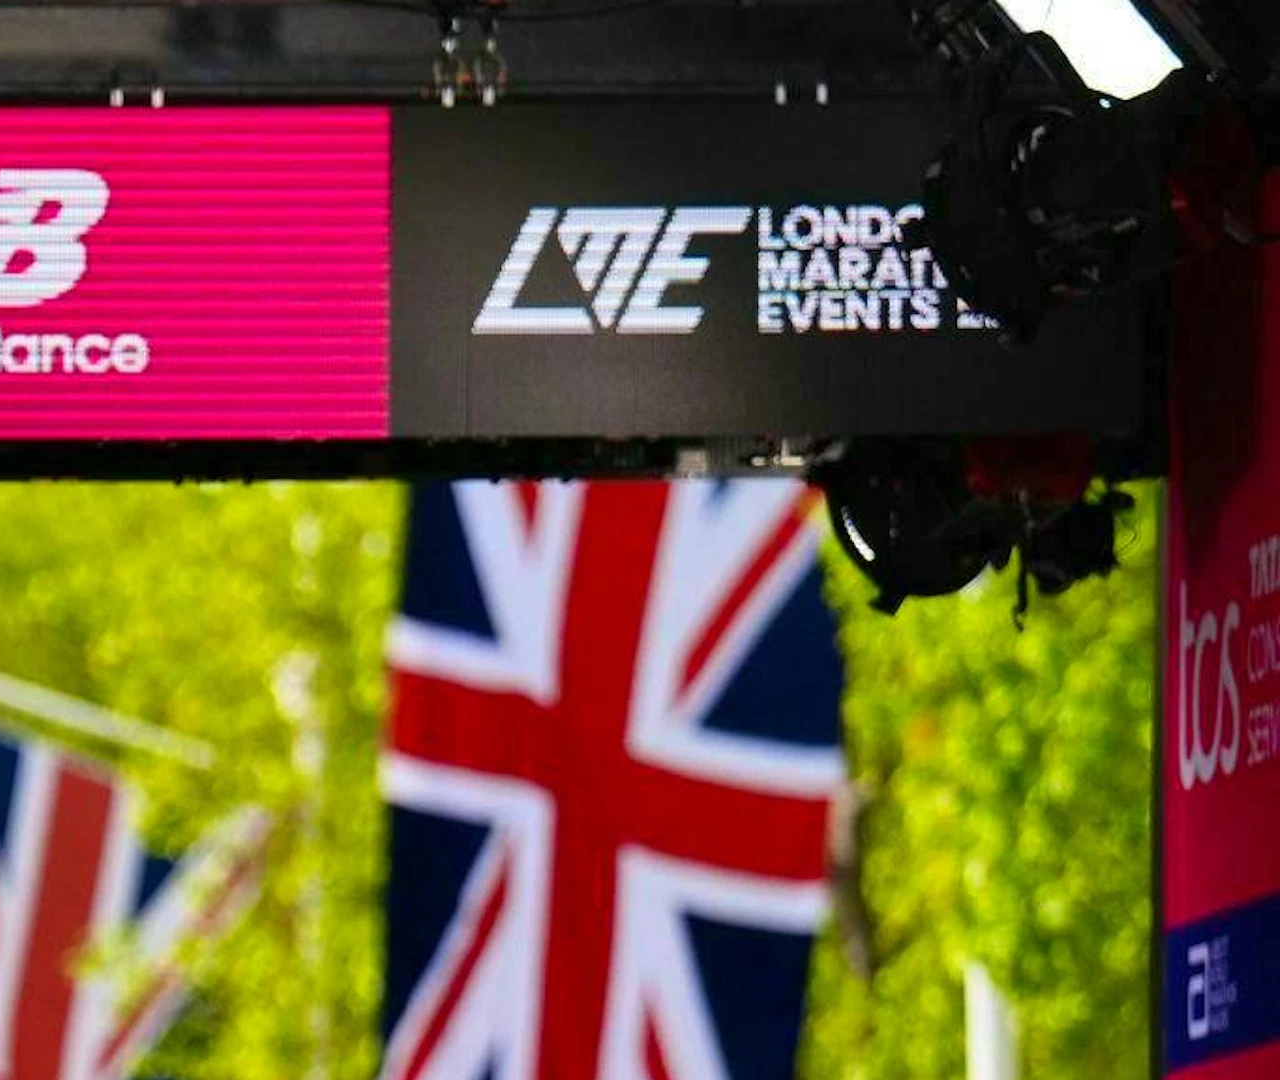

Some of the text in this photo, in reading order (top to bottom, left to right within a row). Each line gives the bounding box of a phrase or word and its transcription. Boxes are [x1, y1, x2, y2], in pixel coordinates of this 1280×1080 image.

[757, 247, 949, 290] MARAT
[757, 289, 941, 333] EVENTS
[1178, 578, 1240, 789] tcs
